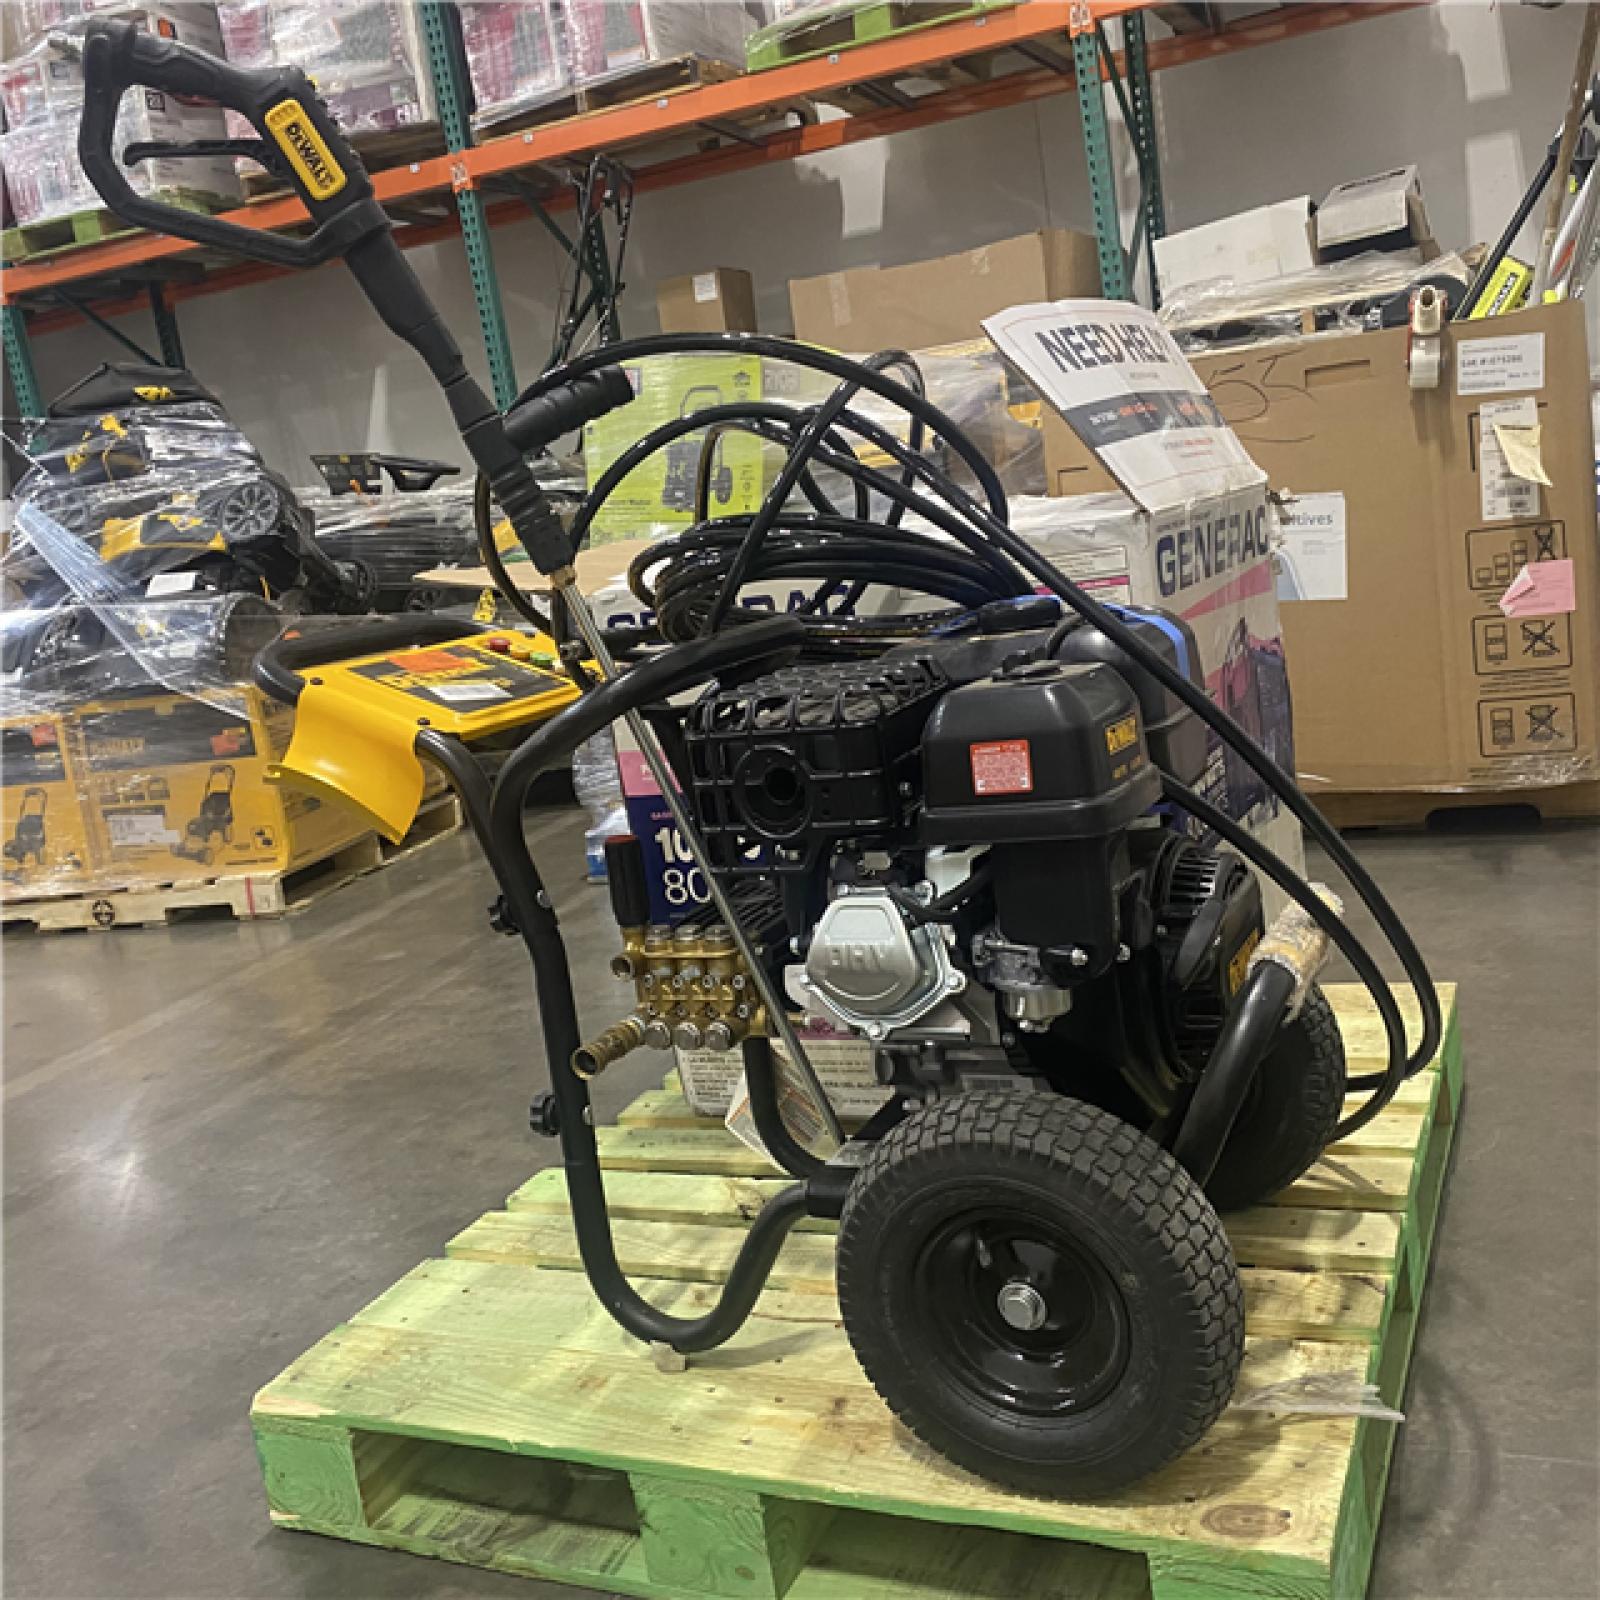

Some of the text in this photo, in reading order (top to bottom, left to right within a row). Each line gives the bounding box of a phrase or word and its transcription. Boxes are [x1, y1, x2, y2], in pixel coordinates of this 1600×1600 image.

[284, 122, 336, 190] DEWALT
[1034, 324, 1126, 373] NEED
[1156, 504, 1269, 598] GENERAC
